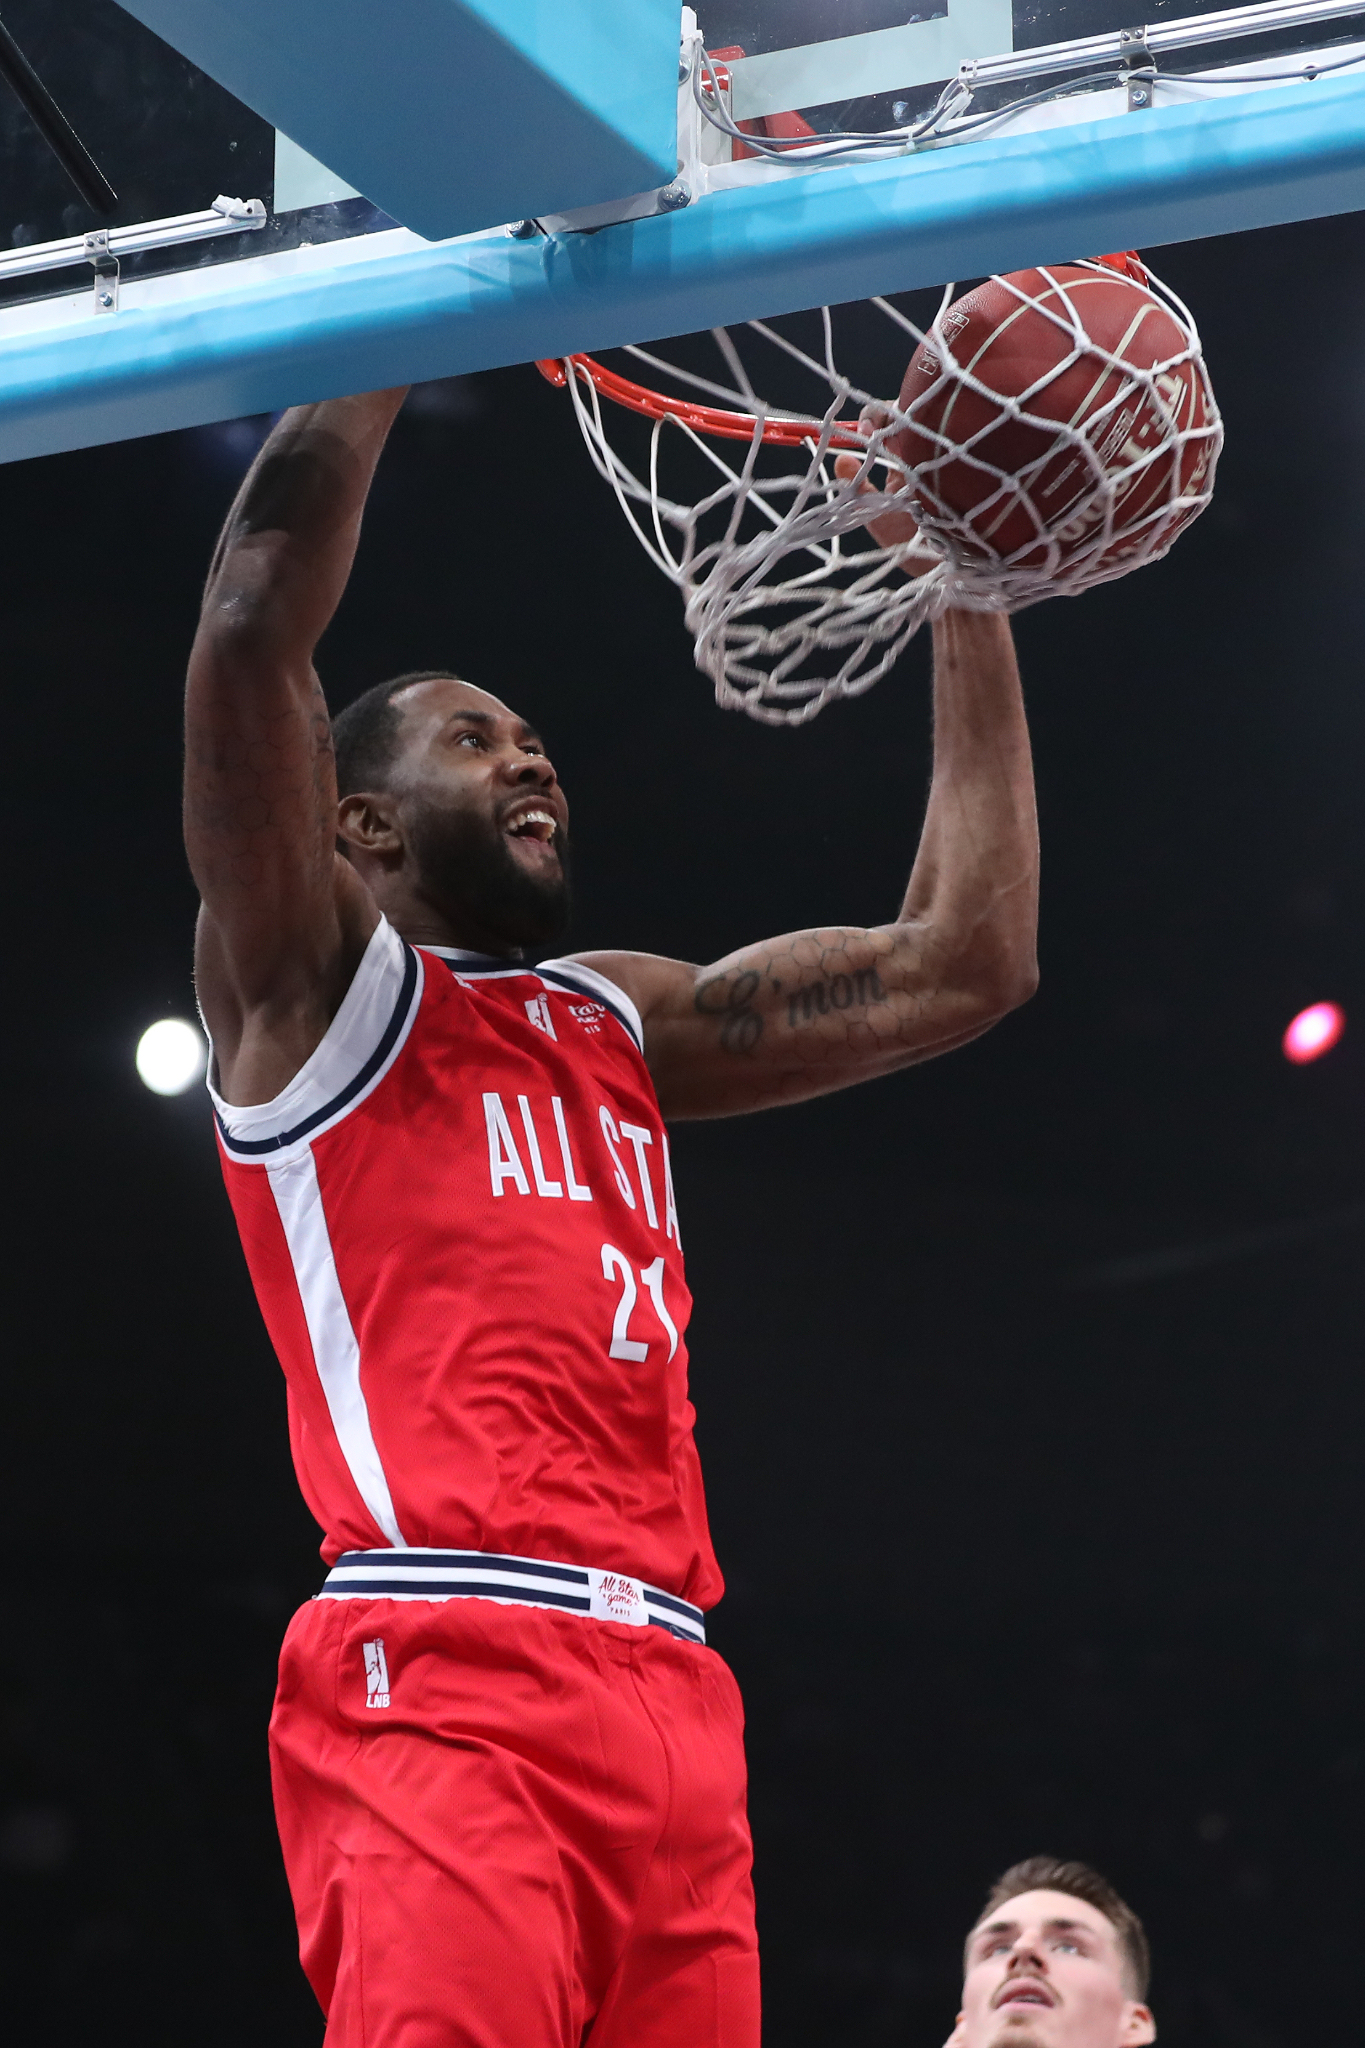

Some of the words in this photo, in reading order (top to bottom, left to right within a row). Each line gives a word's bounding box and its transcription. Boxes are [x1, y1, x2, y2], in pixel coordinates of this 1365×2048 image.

[568, 1002, 606, 1017] tar
[481, 1092, 593, 1201] ALL
[599, 1105, 683, 1251] STA
[601, 1243, 679, 1364] 21
[598, 1575, 616, 1593] All
[618, 1579, 640, 1602] Star
[607, 1593, 633, 1606] game
[610, 1606, 631, 1617] PARIS
[365, 1694, 391, 1709] LNB
